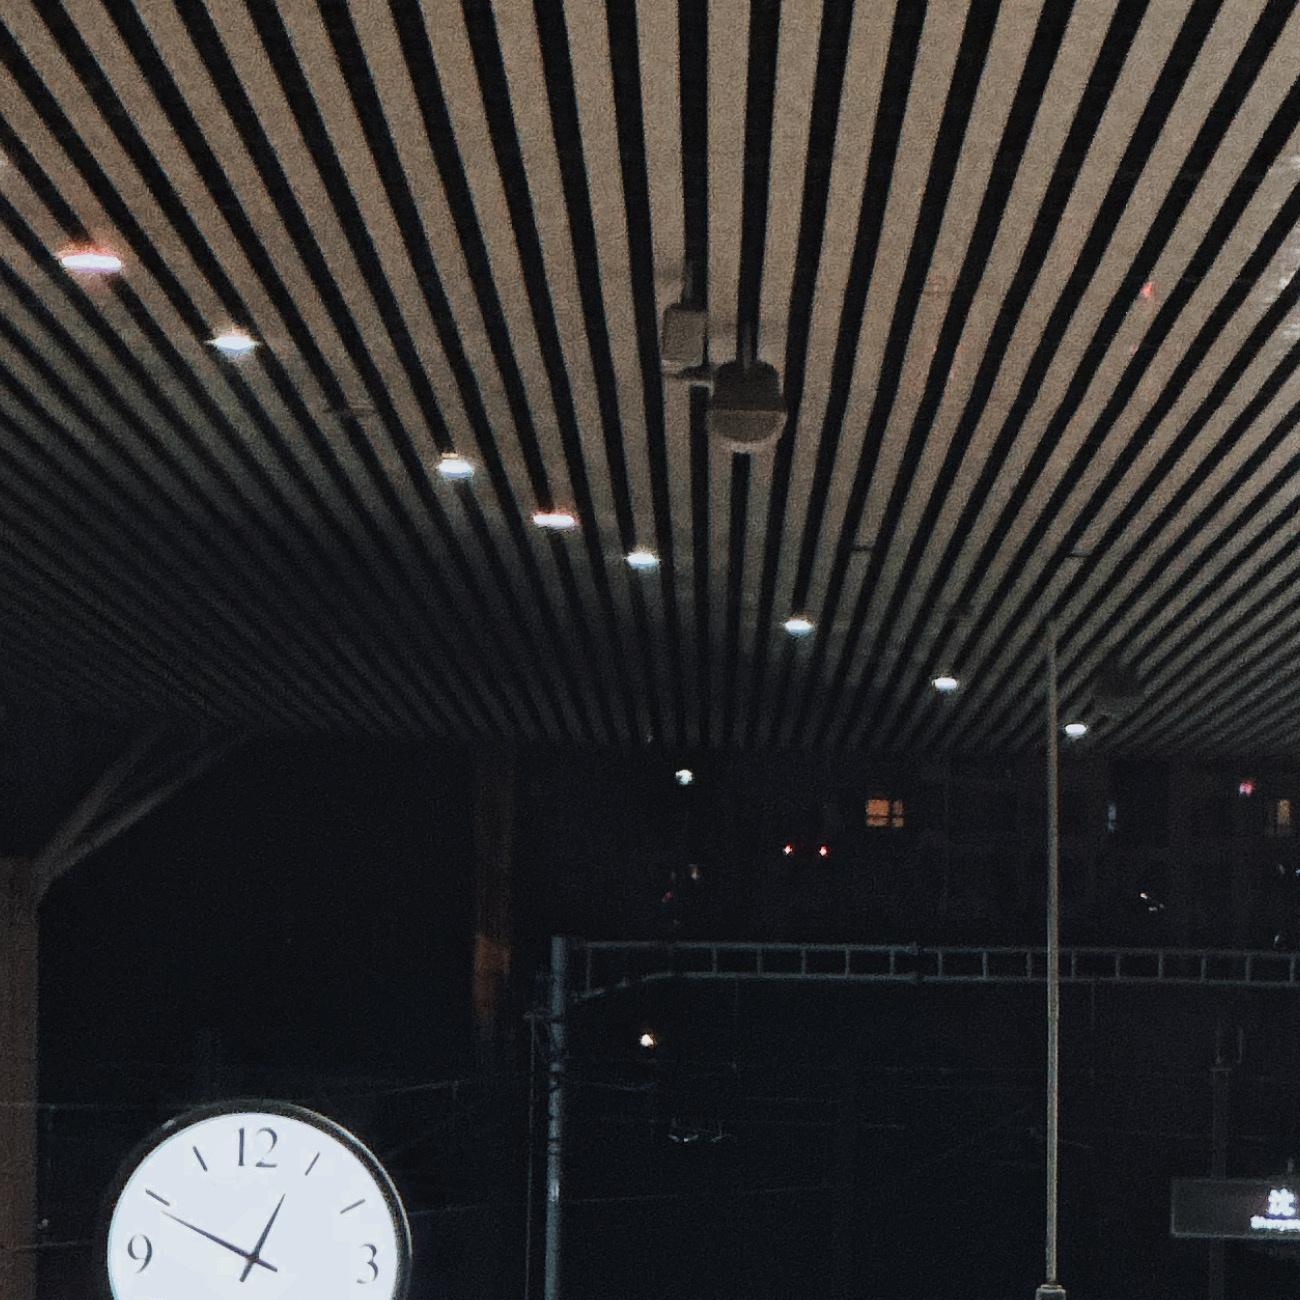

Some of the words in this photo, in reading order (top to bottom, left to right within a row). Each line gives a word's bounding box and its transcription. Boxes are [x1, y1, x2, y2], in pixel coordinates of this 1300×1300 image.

[238, 1127, 278, 1168] 12
[127, 1234, 153, 1274] 9
[357, 1243, 379, 1284] 3
